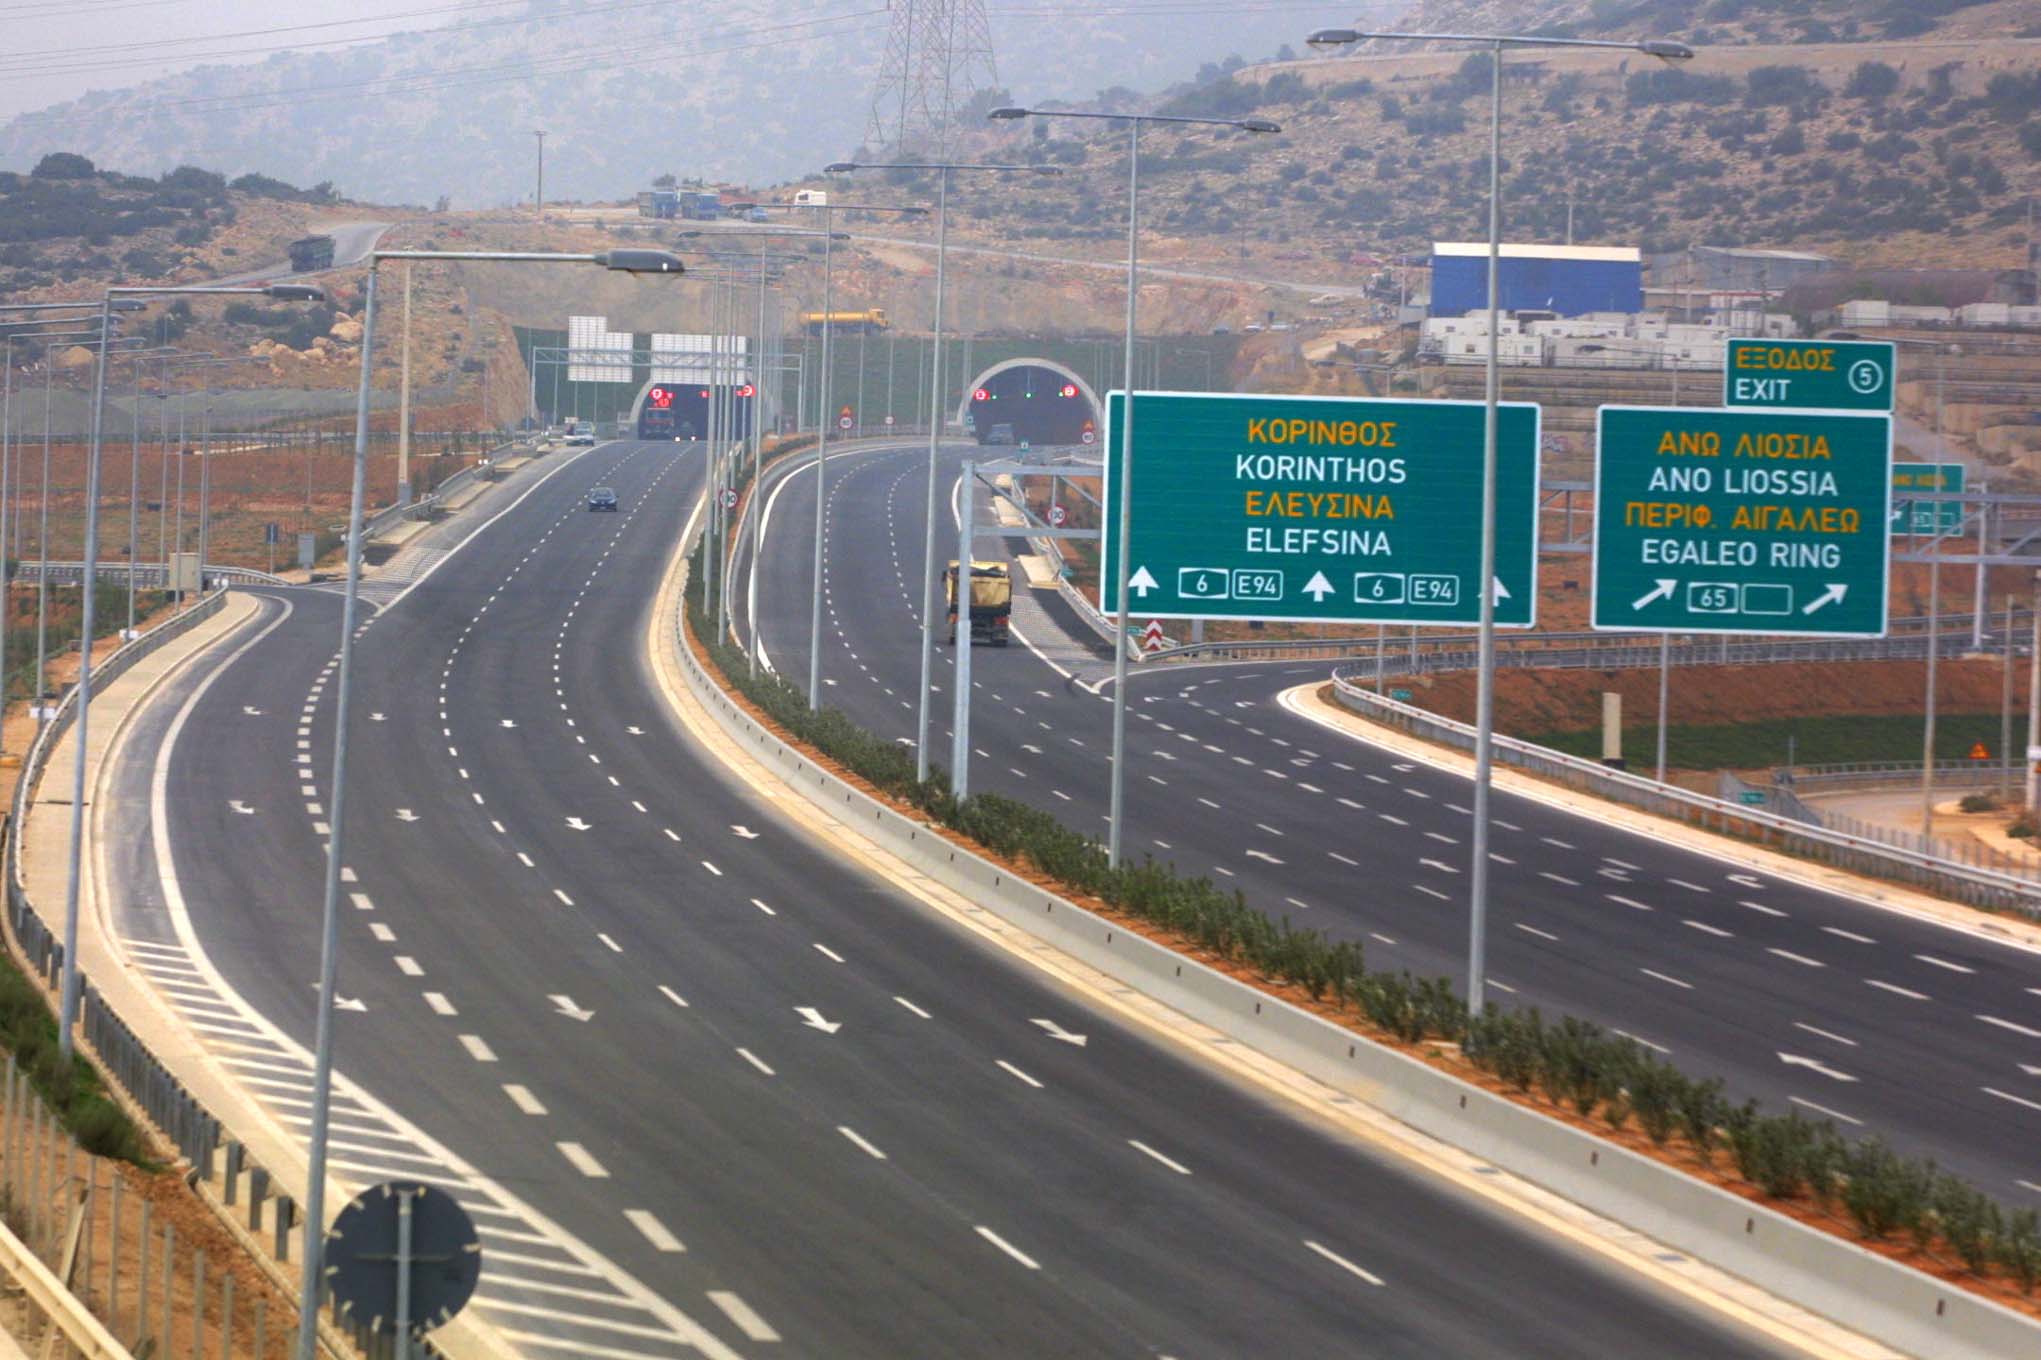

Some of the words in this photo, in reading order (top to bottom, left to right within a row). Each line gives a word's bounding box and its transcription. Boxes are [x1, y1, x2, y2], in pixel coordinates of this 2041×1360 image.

[1737, 347, 1833, 371] ΕΞΟΔΟΣ
[1736, 378, 1791, 400] EXIT
[1860, 367, 1872, 386] 5
[1248, 418, 1396, 447] ΚΟΡΙΝΘΟΣ
[1658, 431, 1720, 456] ΑΝΩ
[1735, 433, 1830, 459] ΛΙΟΣΙΑ
[1236, 454, 1406, 484] KORINTHOS
[1649, 467, 1711, 492] ANO
[1725, 469, 1837, 495] LIOSSIA
[1246, 490, 1393, 519] ΕΛΕΥΣΙΝΑ
[1625, 502, 1717, 528] ΠΕΡΙΦ.
[1733, 506, 1858, 533] ΑΙΓΑΛΕΩ
[1247, 527, 1391, 555] ELEFSINA
[1642, 539, 1757, 566] EGALEO
[1771, 542, 1840, 568] RING
[1196, 574, 1208, 593] 6
[1238, 575, 1276, 594] E94
[1372, 578, 1384, 597] 6
[1414, 580, 1452, 598] E94
[1701, 588, 1728, 609] 65
